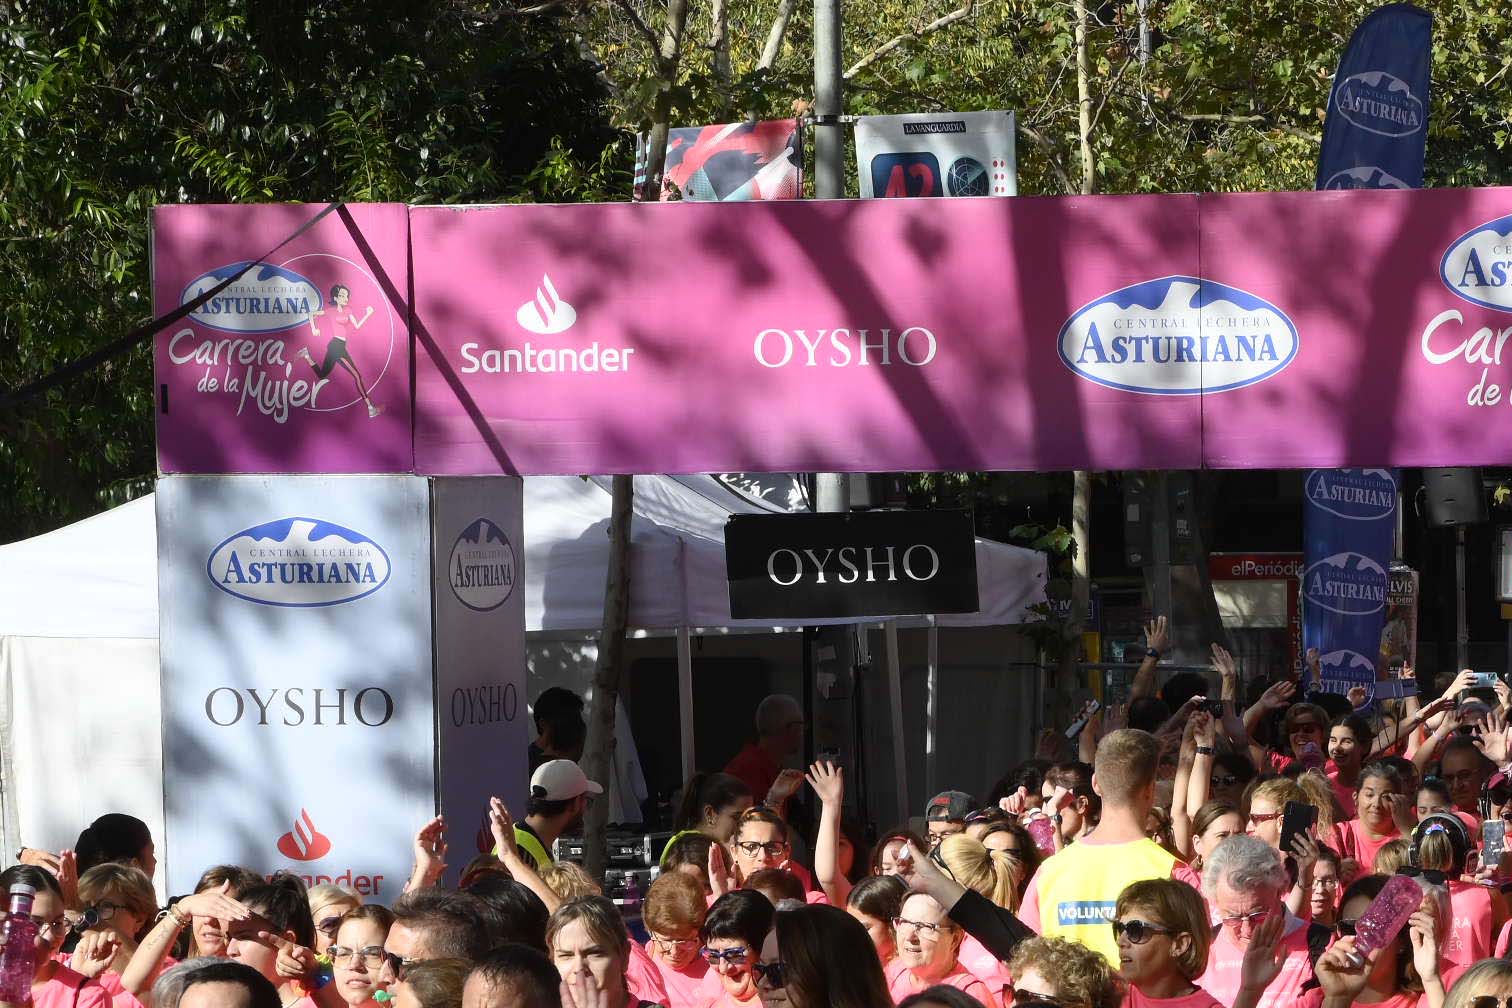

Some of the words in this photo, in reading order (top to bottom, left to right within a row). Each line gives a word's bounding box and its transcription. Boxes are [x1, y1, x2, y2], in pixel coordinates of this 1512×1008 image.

[1340, 86, 1419, 126] ASTURIANA
[1076, 321, 1280, 364] ASTURIANA
[1113, 318, 1187, 329] CENTRAL
[168, 328, 285, 366] Carrera
[461, 341, 634, 374] Santander
[753, 326, 937, 367] OYSHO
[197, 367, 220, 392] de
[224, 367, 240, 392] la
[236, 363, 330, 423] Mujer
[1467, 368, 1502, 406] de
[1313, 475, 1393, 508] ASTURIANA
[222, 551, 378, 584] ASTURIANA
[250, 549, 308, 557] CENTRAL
[313, 549, 372, 557] LECHERA
[454, 556, 512, 588] ASTURIANA
[767, 544, 940, 587] OYSHO
[205, 687, 394, 727] OYSHO
[451, 683, 517, 727] OYSHO
